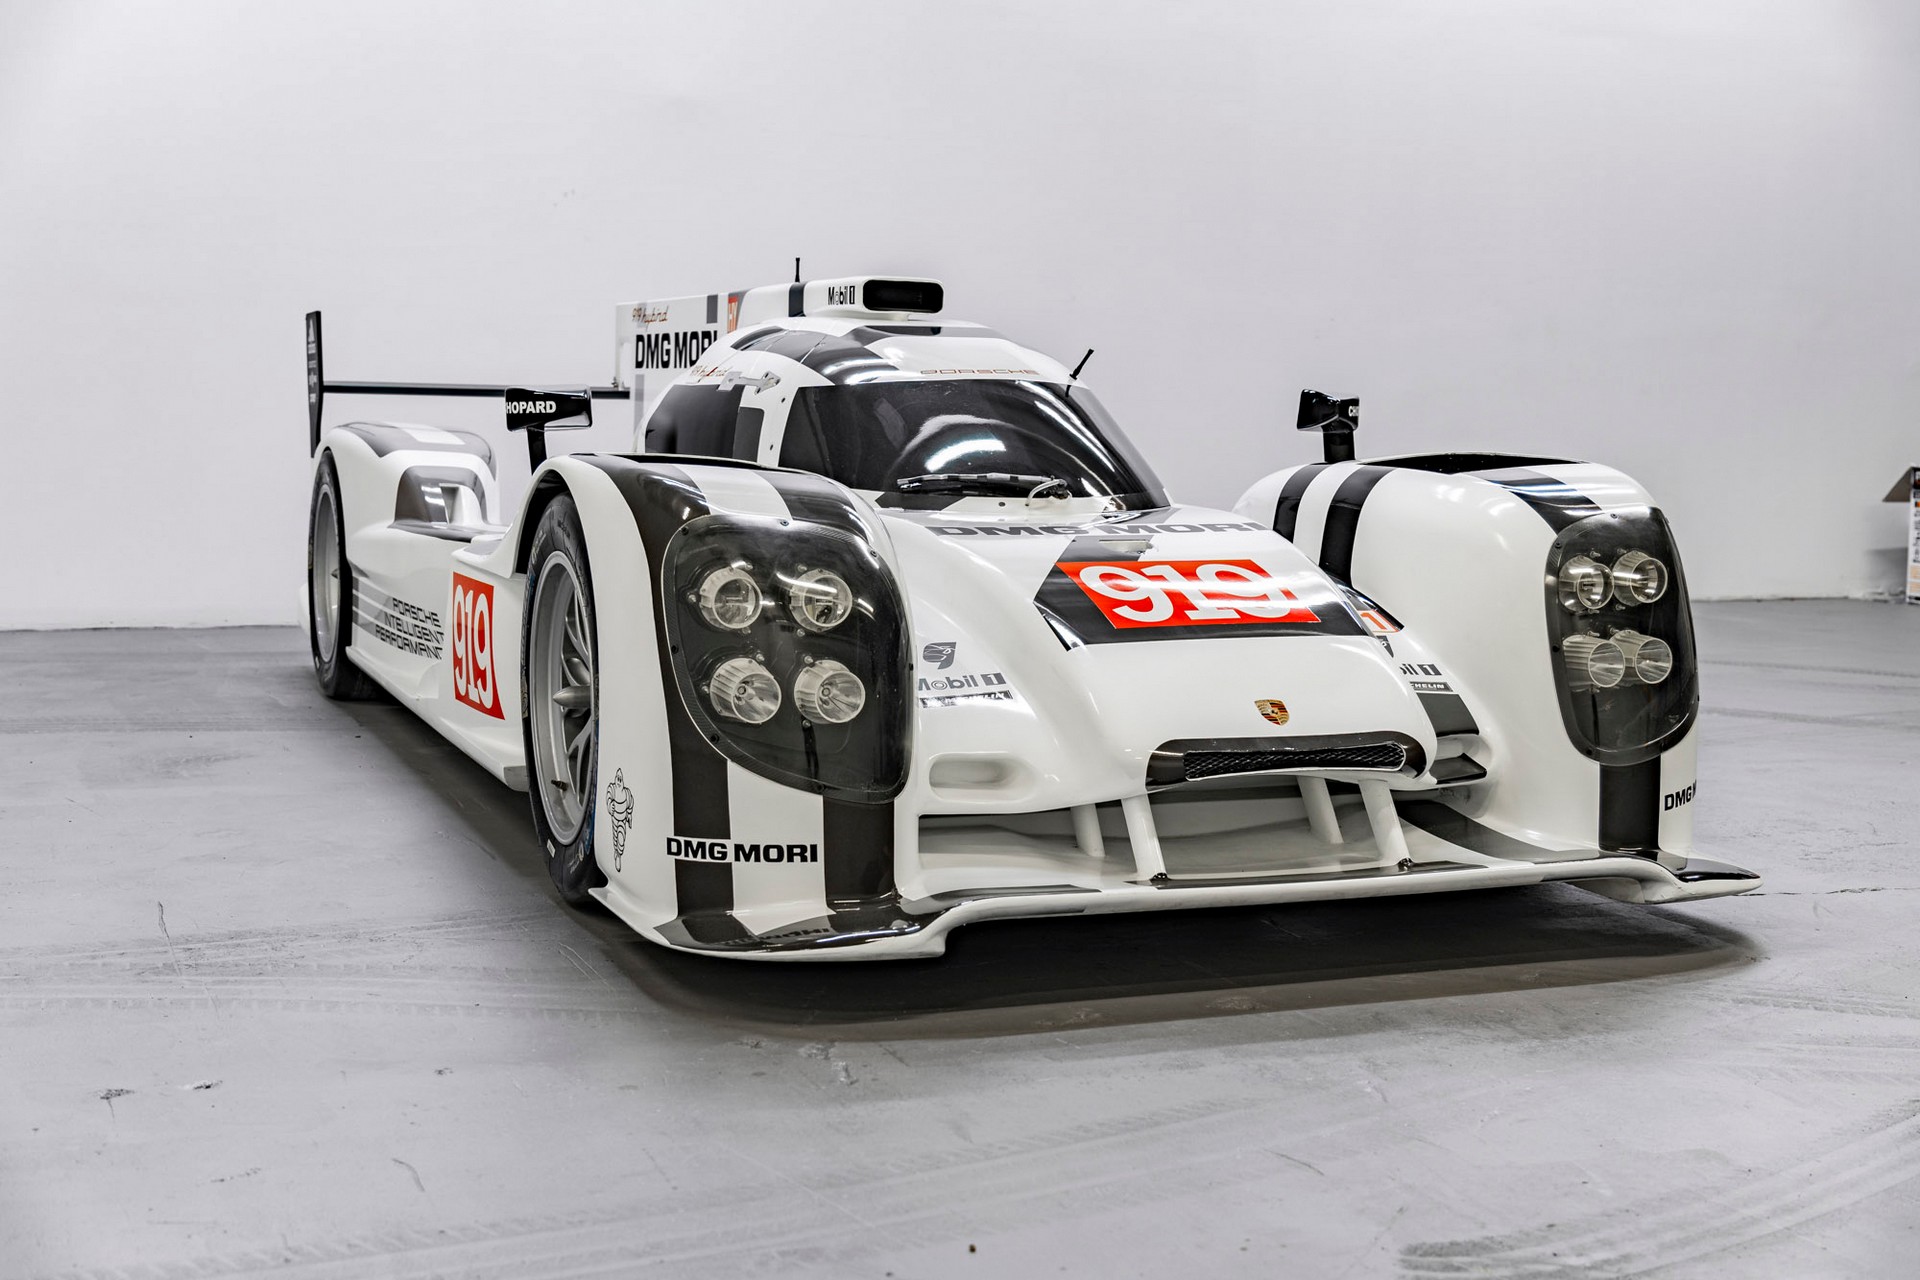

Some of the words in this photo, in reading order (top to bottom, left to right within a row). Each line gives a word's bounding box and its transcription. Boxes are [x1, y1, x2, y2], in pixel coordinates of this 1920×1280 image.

[828, 286, 848, 305] Mobil
[635, 332, 671, 369] DMG
[925, 526, 1090, 536] DMG
[1094, 522, 1267, 534] MORI
[1080, 563, 1292, 622] 919
[392, 597, 442, 628] PORSCHE
[453, 584, 493, 709] 919
[1664, 785, 1692, 811] DMG
[667, 837, 727, 861] DMG
[734, 844, 817, 862] MORI
